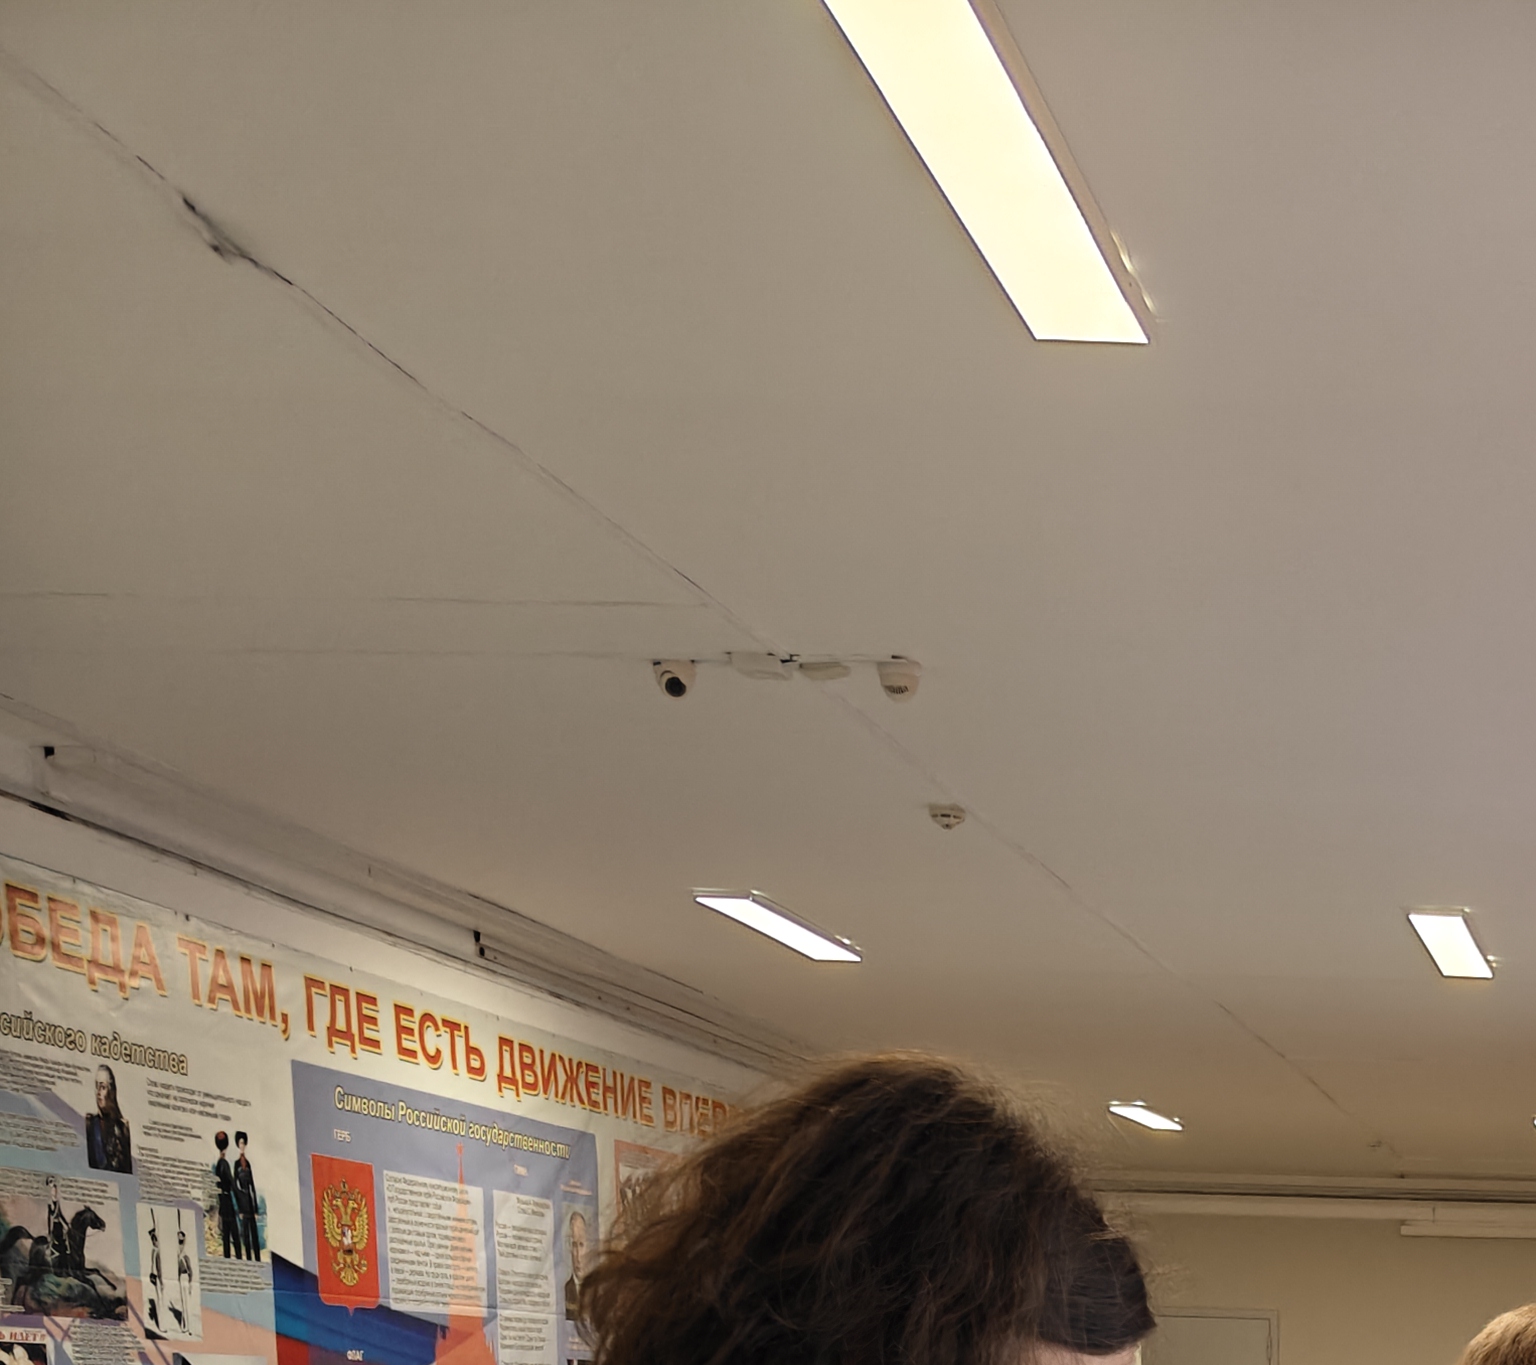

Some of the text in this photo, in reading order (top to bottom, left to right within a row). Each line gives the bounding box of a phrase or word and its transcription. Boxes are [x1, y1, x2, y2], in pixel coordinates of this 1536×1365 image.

[0, 880, 738, 1140] БЕДА ТАМ, ГДЕ ЕСТЬ ДВИЖЕНИЕ ВПЕР
[90, 1031, 189, 1076] кадетства
[333, 1128, 352, 1144] ГЕРБ
[334, 1086, 570, 1160] Символы Российской государственности
[346, 1350, 364, 1361] ФЛАГ
